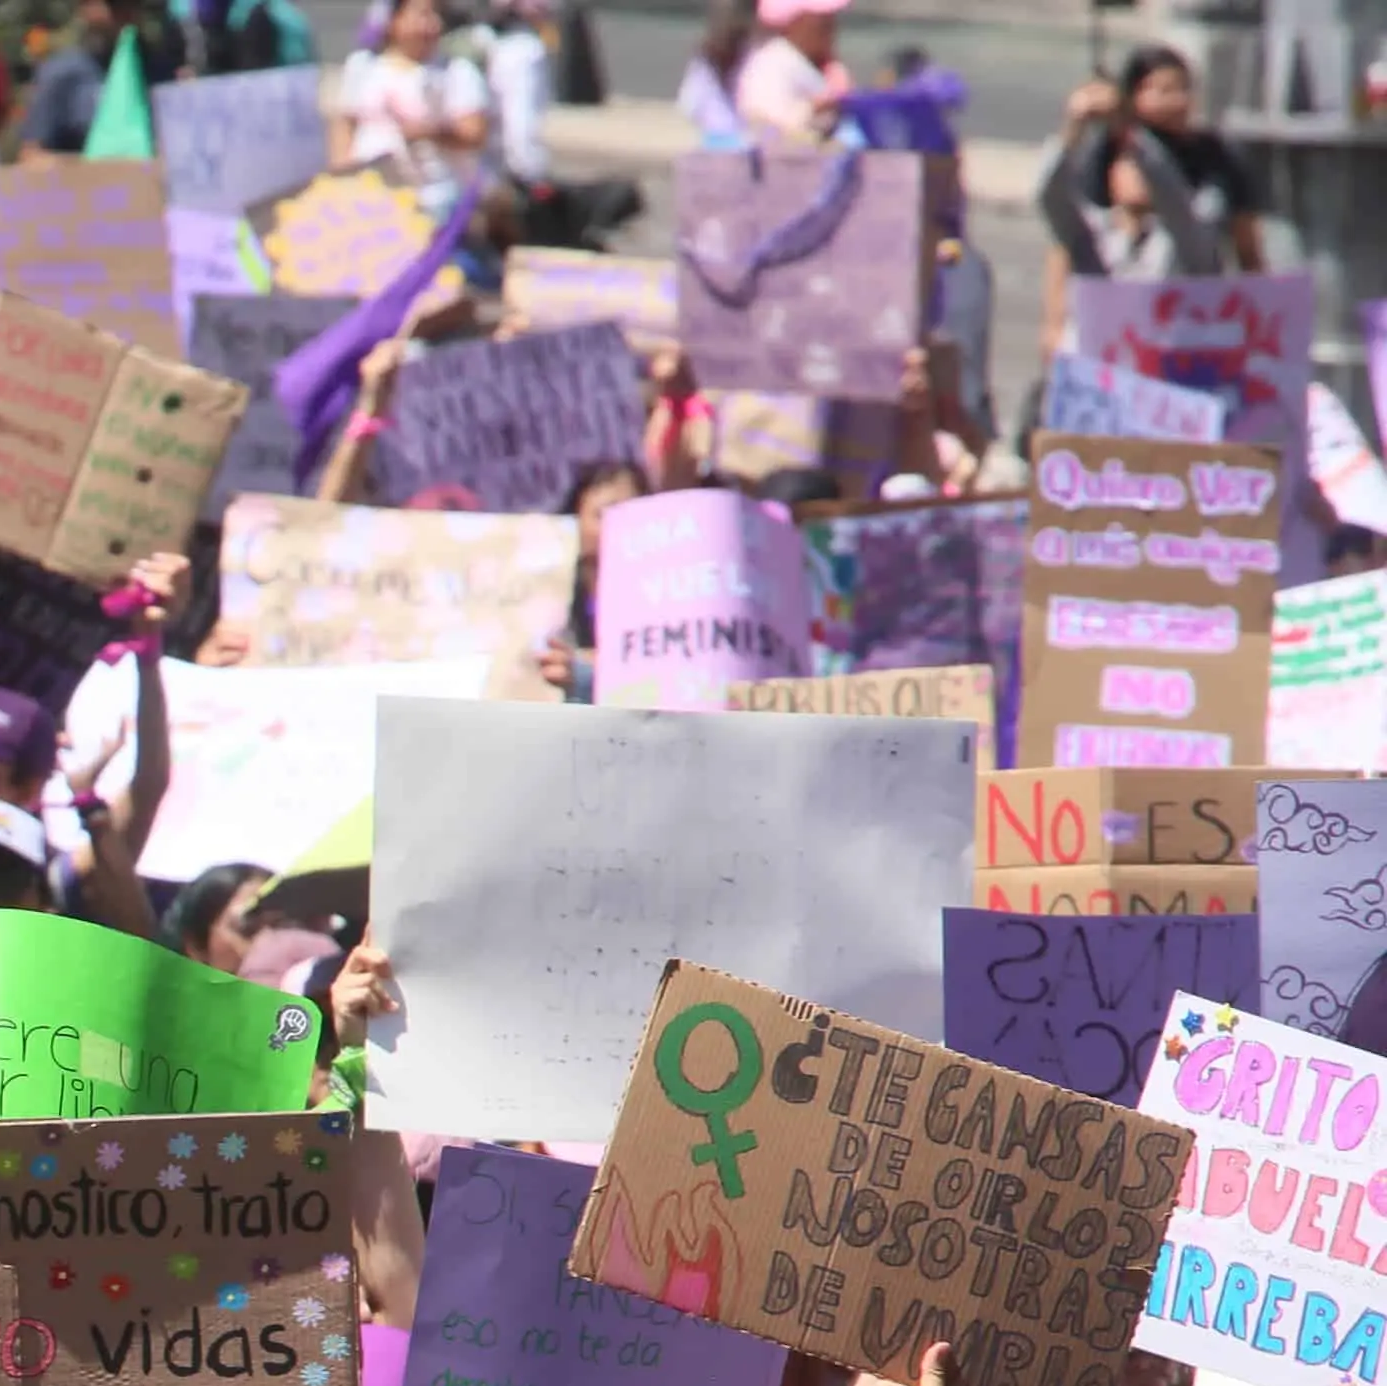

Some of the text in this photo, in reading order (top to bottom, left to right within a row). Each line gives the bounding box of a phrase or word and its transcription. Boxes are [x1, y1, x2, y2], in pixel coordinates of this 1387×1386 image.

[985, 780, 1236, 866] NO ES
[118, 1041, 201, 1114] una
[770, 1009, 926, 1132] ¿TE
[923, 1063, 1181, 1210] CANSAS
[1173, 1034, 1382, 1152] GRITO
[826, 1120, 914, 1193] DE
[193, 1171, 331, 1239] trato
[761, 1250, 845, 1333] DE
[782, 1167, 1142, 1355] NOSOTRAS
[90, 1306, 300, 1380] vidas
[440, 1310, 662, 1368] eso no te da
